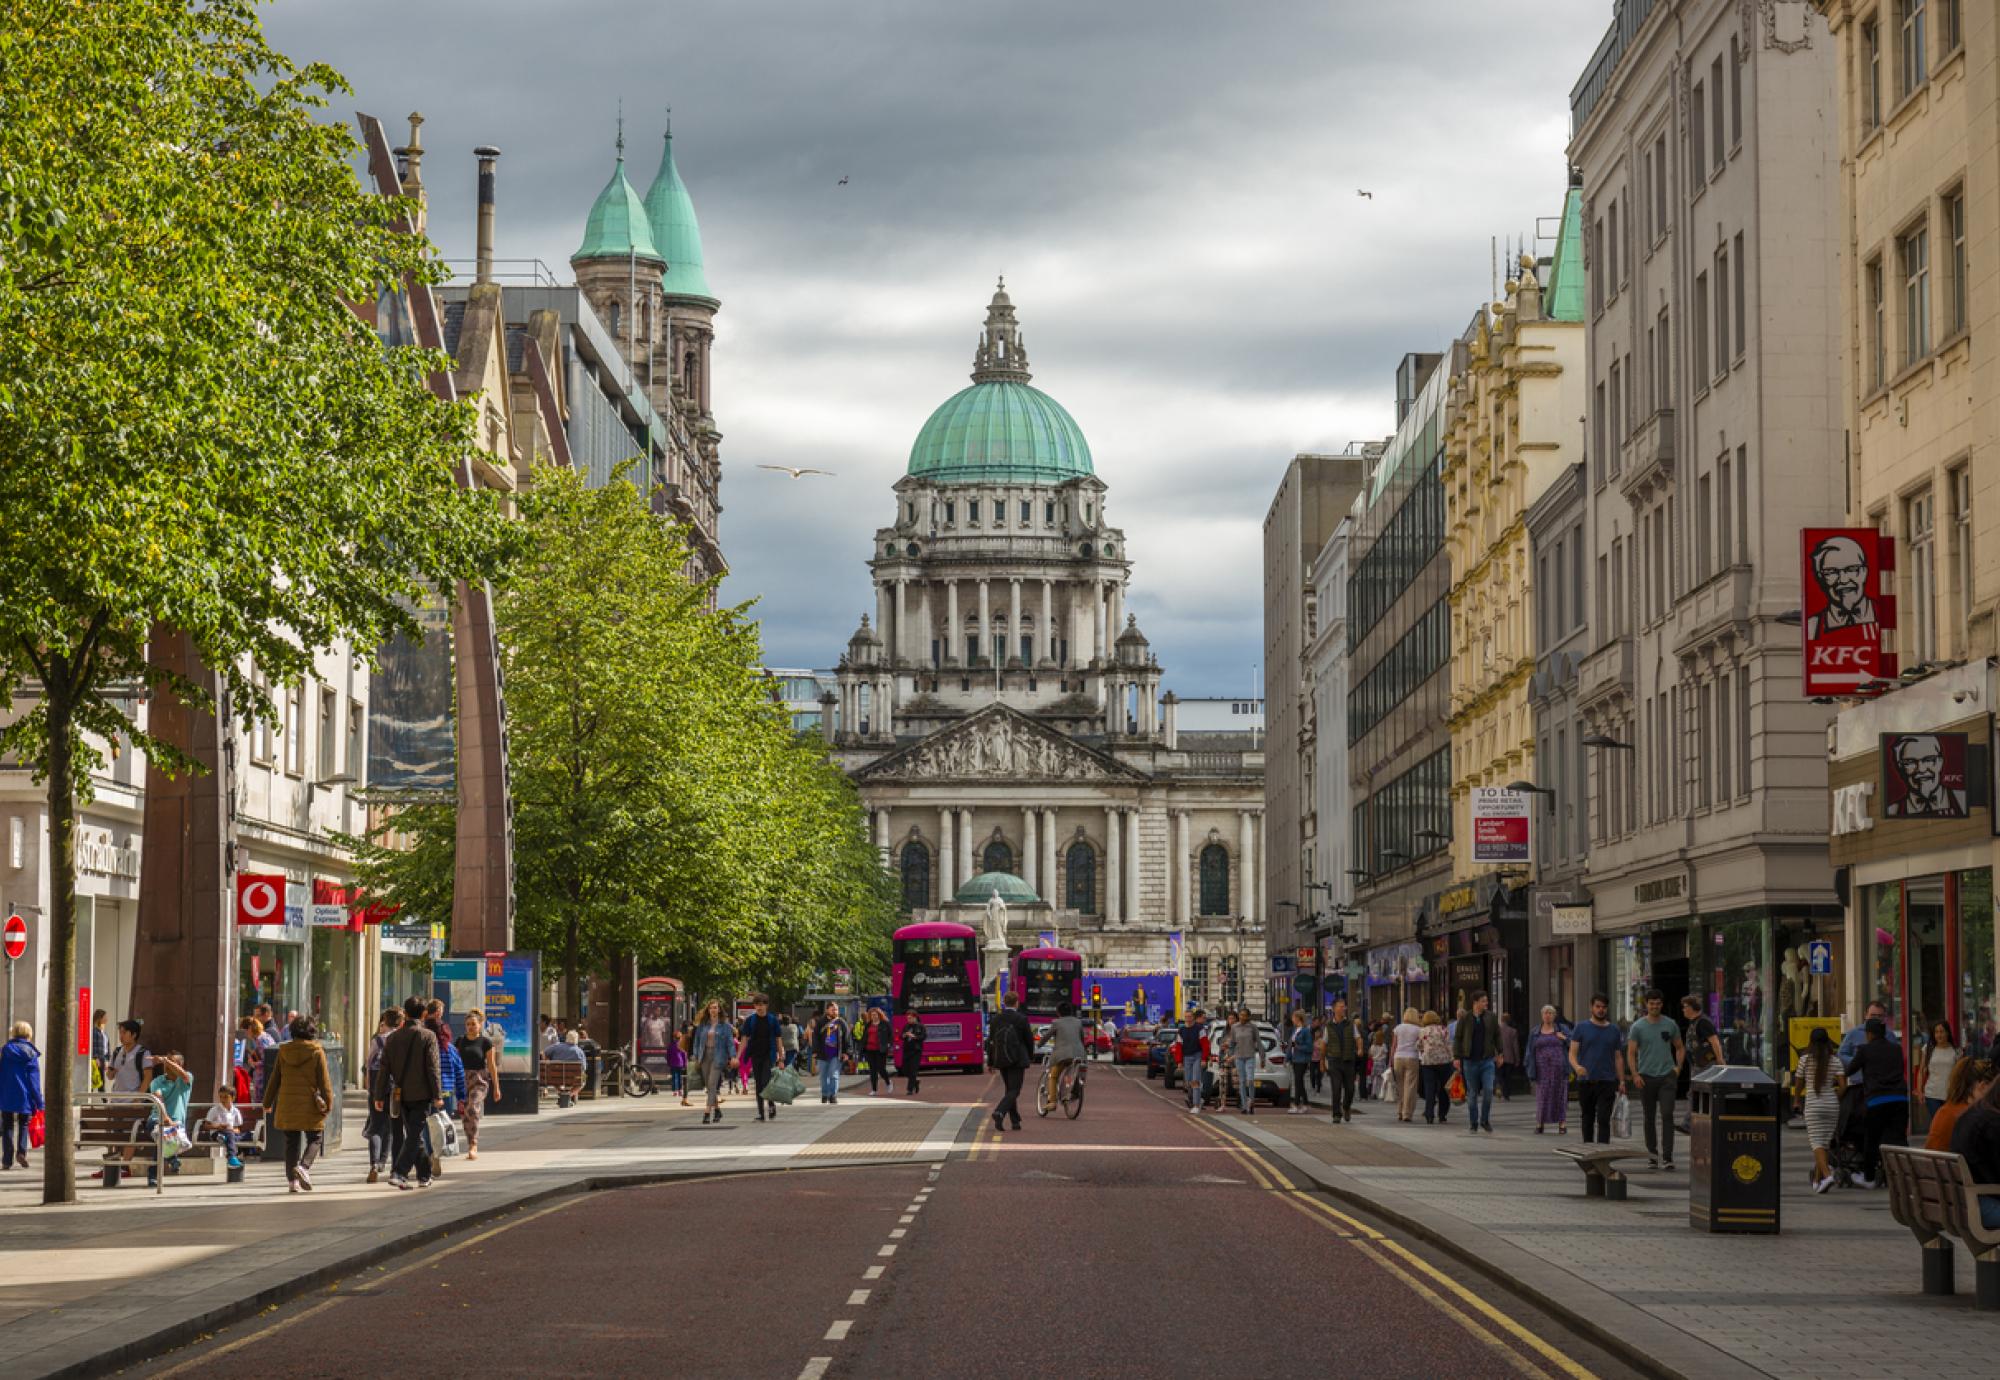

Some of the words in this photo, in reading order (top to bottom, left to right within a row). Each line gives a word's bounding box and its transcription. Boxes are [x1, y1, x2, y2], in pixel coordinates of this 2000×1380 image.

[1810, 645, 1872, 666] KFC
[1944, 774, 1963, 783] KFC
[1480, 788, 1497, 797] TO
[1501, 788, 1521, 797] LET
[1833, 781, 1874, 836] KFC
[315, 907, 339, 916] Optical
[1558, 911, 1585, 919] NEW
[314, 916, 341, 924] Express
[1556, 920, 1589, 928] LOOK
[1728, 1131, 1768, 1142] LITTER
